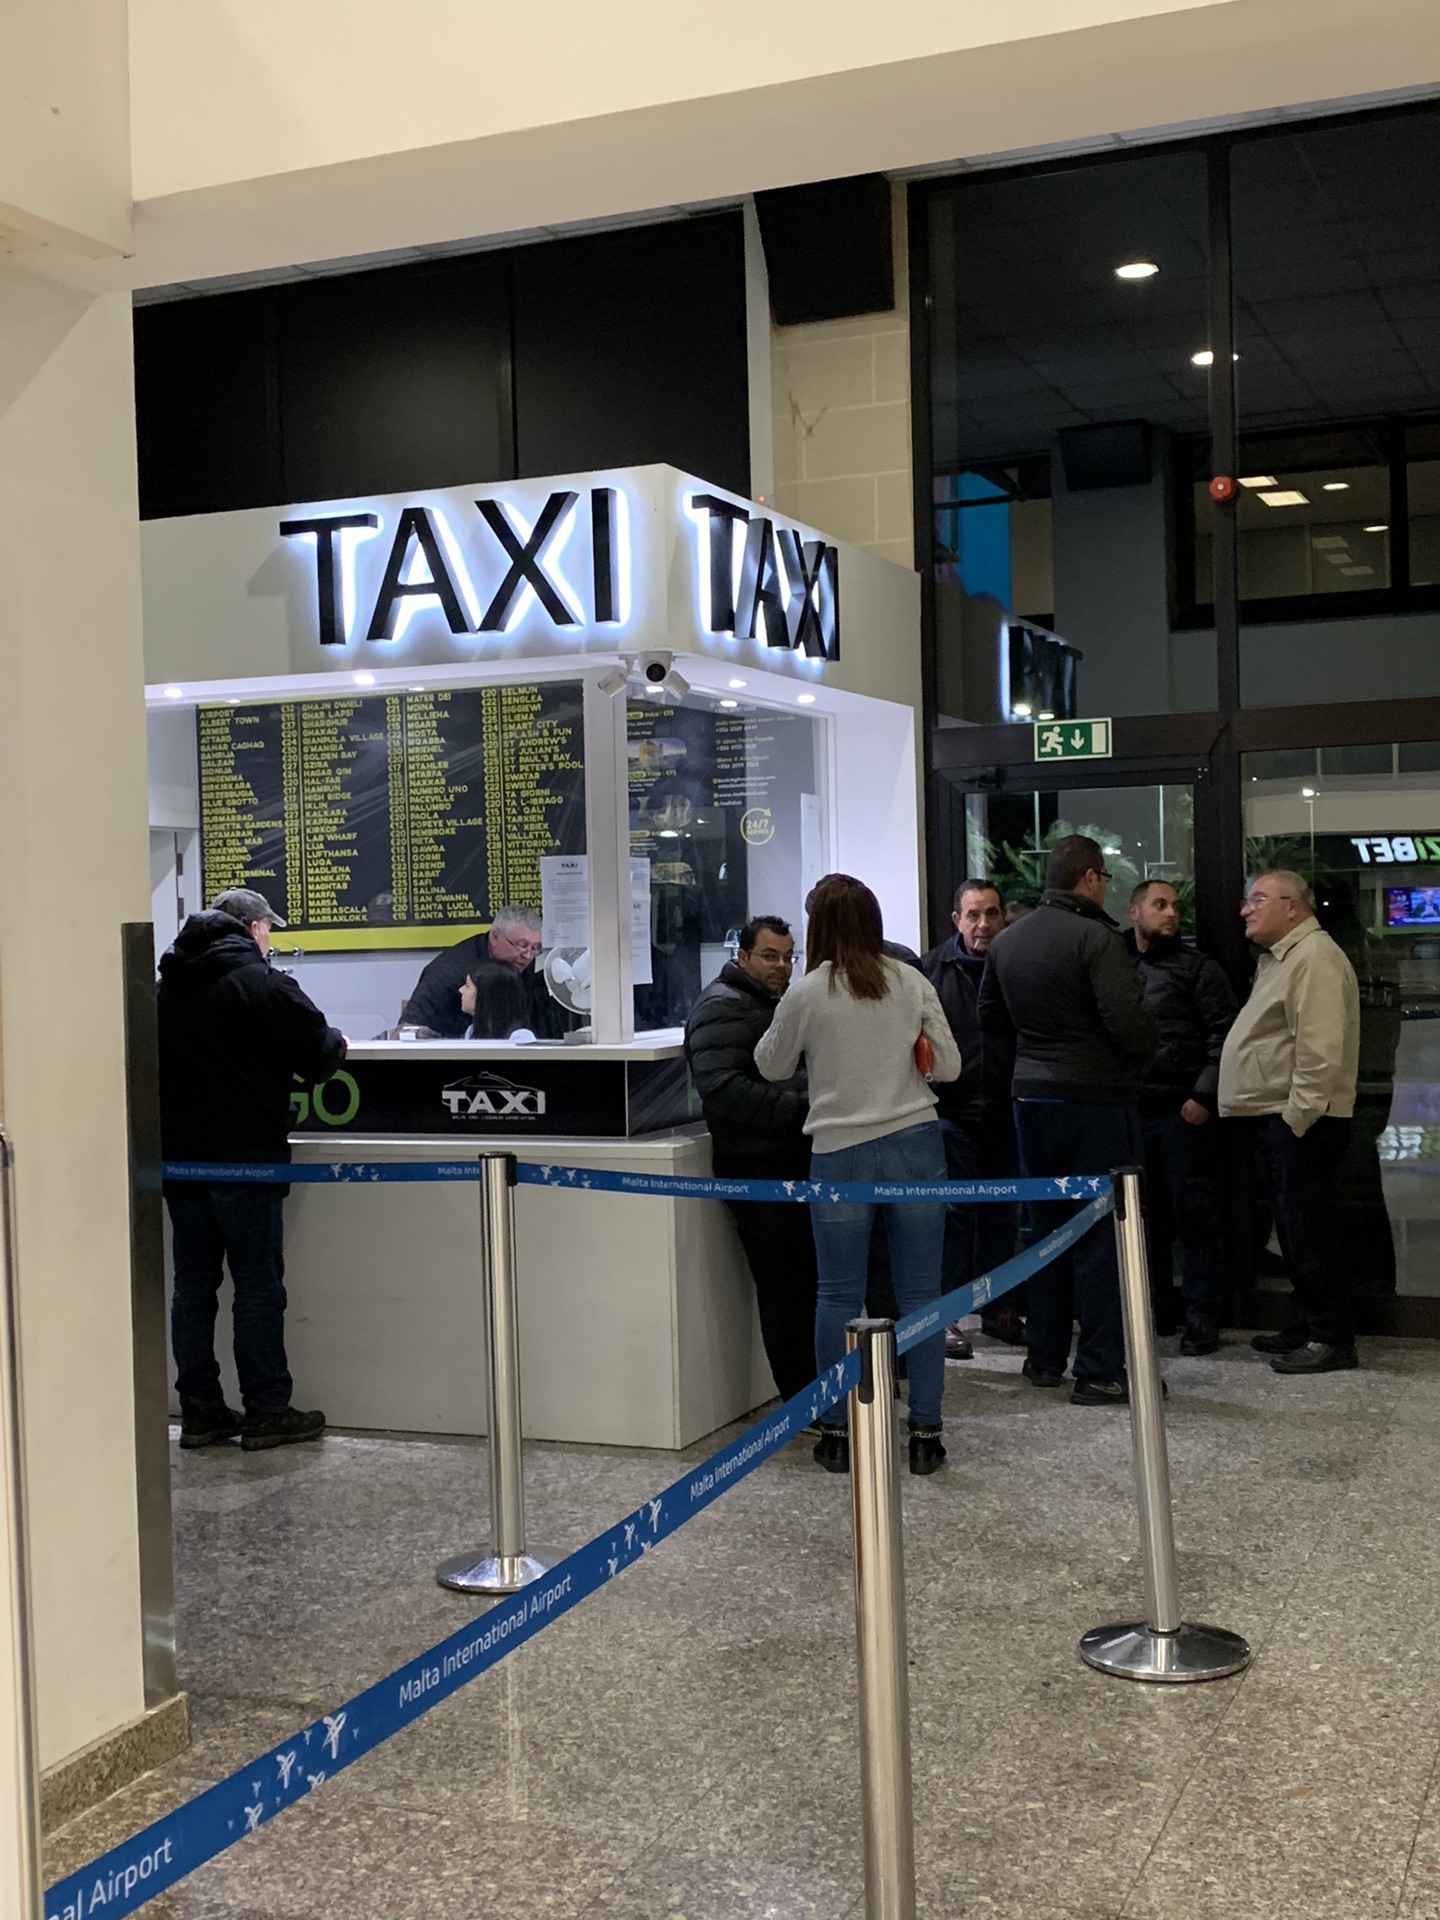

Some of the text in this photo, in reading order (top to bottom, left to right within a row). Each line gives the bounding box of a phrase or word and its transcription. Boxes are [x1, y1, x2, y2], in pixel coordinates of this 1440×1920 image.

[280, 488, 620, 645] TAXI
[692, 495, 840, 661] TAXI
[199, 708, 234, 718] AIRPORT
[199, 715, 259, 726] ALBERT TOWN
[537, 719, 557, 728] CITY
[407, 727, 437, 737] MOSTA
[448, 785, 467, 793] UNO
[414, 903, 442, 911] SANTA
[414, 911, 443, 919] SANTA
[442, 1090, 546, 1114] TAXI
[622, 1176, 750, 1194] Malta International Airport
[874, 1184, 1017, 1196] Malta International Airport
[690, 1415, 790, 1504] Malta International Airport
[399, 1574, 572, 1709] Malta International Airport
[89, 1837, 173, 1914] Airport
